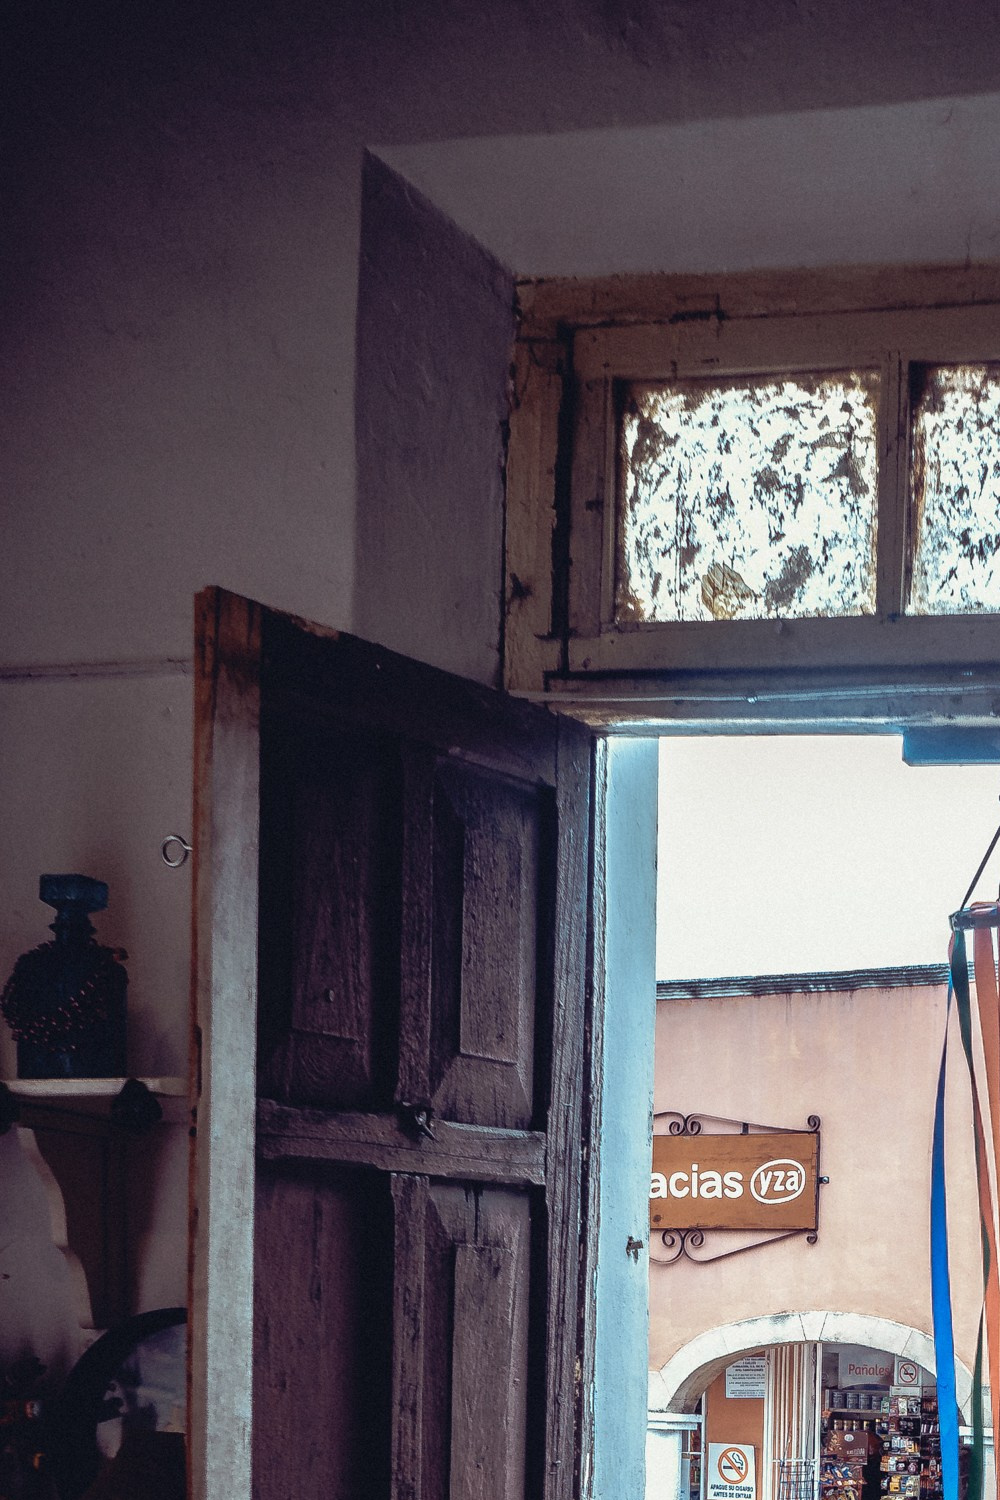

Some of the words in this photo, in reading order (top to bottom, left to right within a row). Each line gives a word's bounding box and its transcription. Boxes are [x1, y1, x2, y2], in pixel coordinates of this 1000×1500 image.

[649, 1163, 744, 1199] acias
[759, 1169, 800, 1197] yza
[848, 1363, 890, 1376] Pañales
